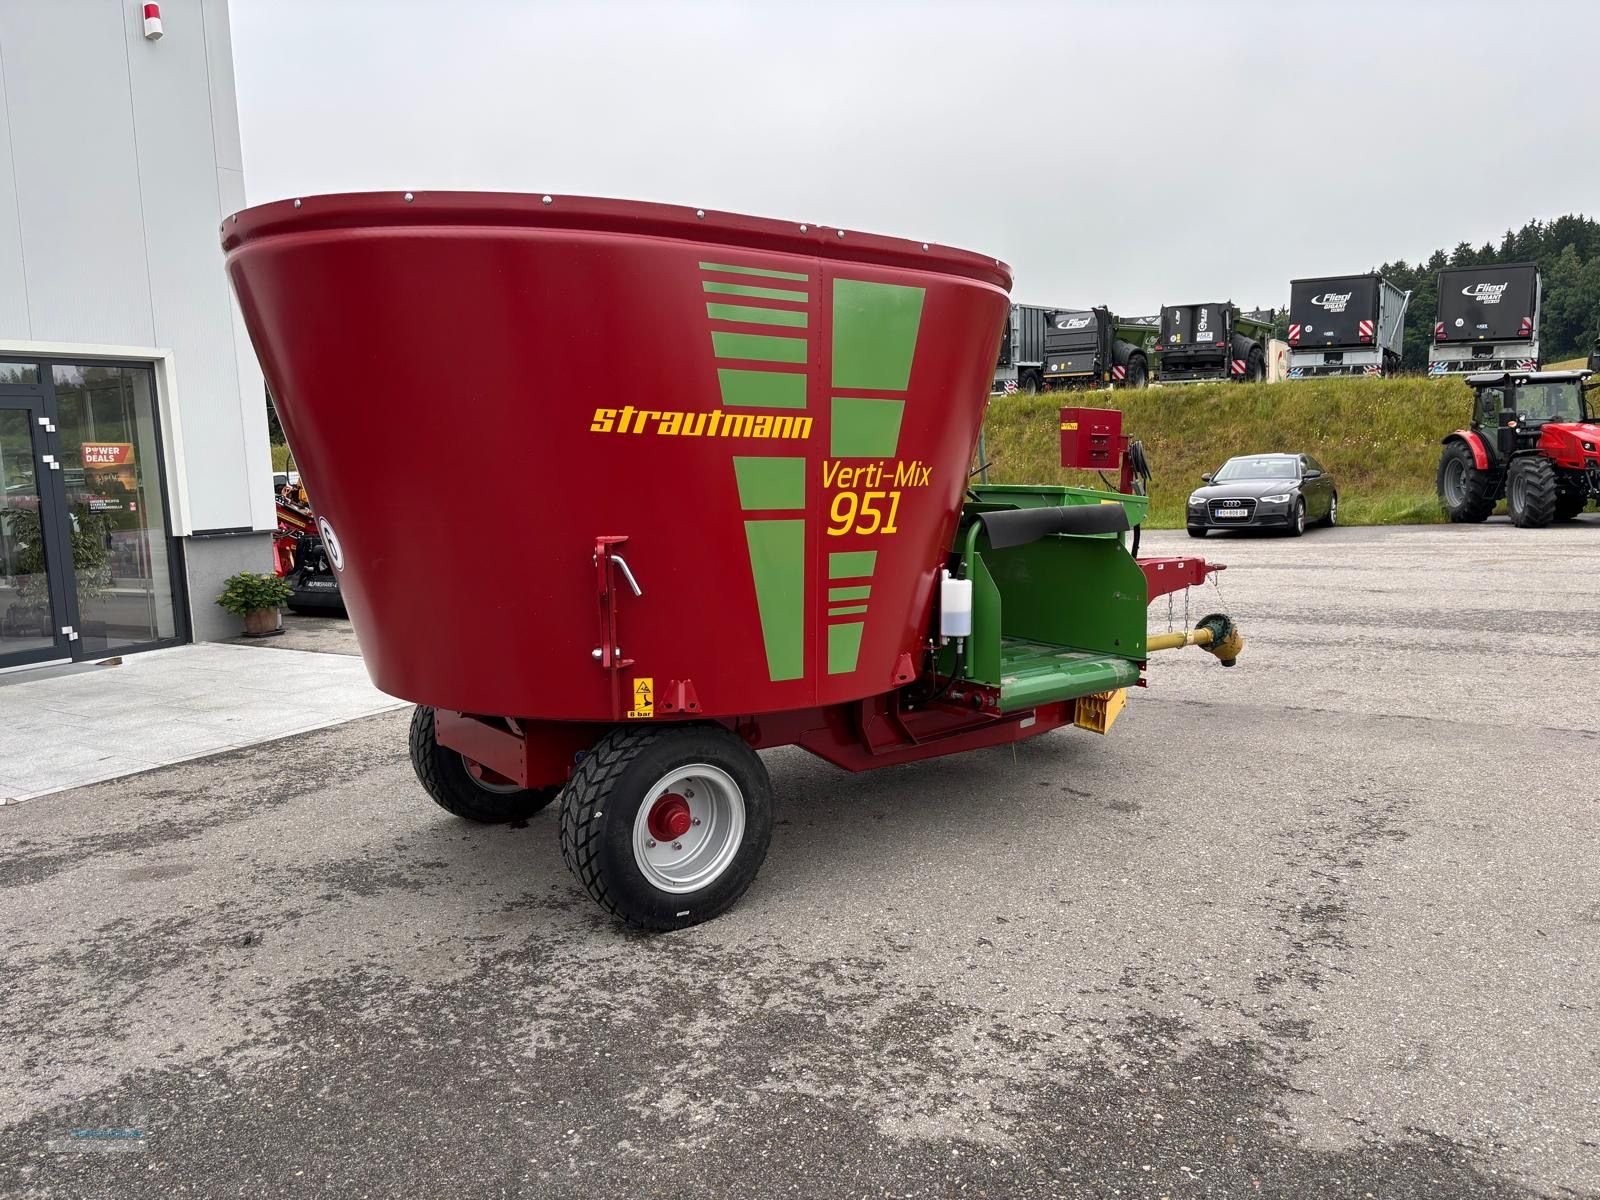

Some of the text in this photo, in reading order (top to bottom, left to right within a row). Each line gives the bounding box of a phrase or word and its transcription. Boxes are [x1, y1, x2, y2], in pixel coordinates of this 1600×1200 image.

[1323, 291, 1352, 302] Fliegl
[1475, 282, 1508, 293] Fliegl
[590, 406, 813, 439] strautmann
[823, 460, 933, 488] Verti-Mix
[827, 491, 901, 536] 951
